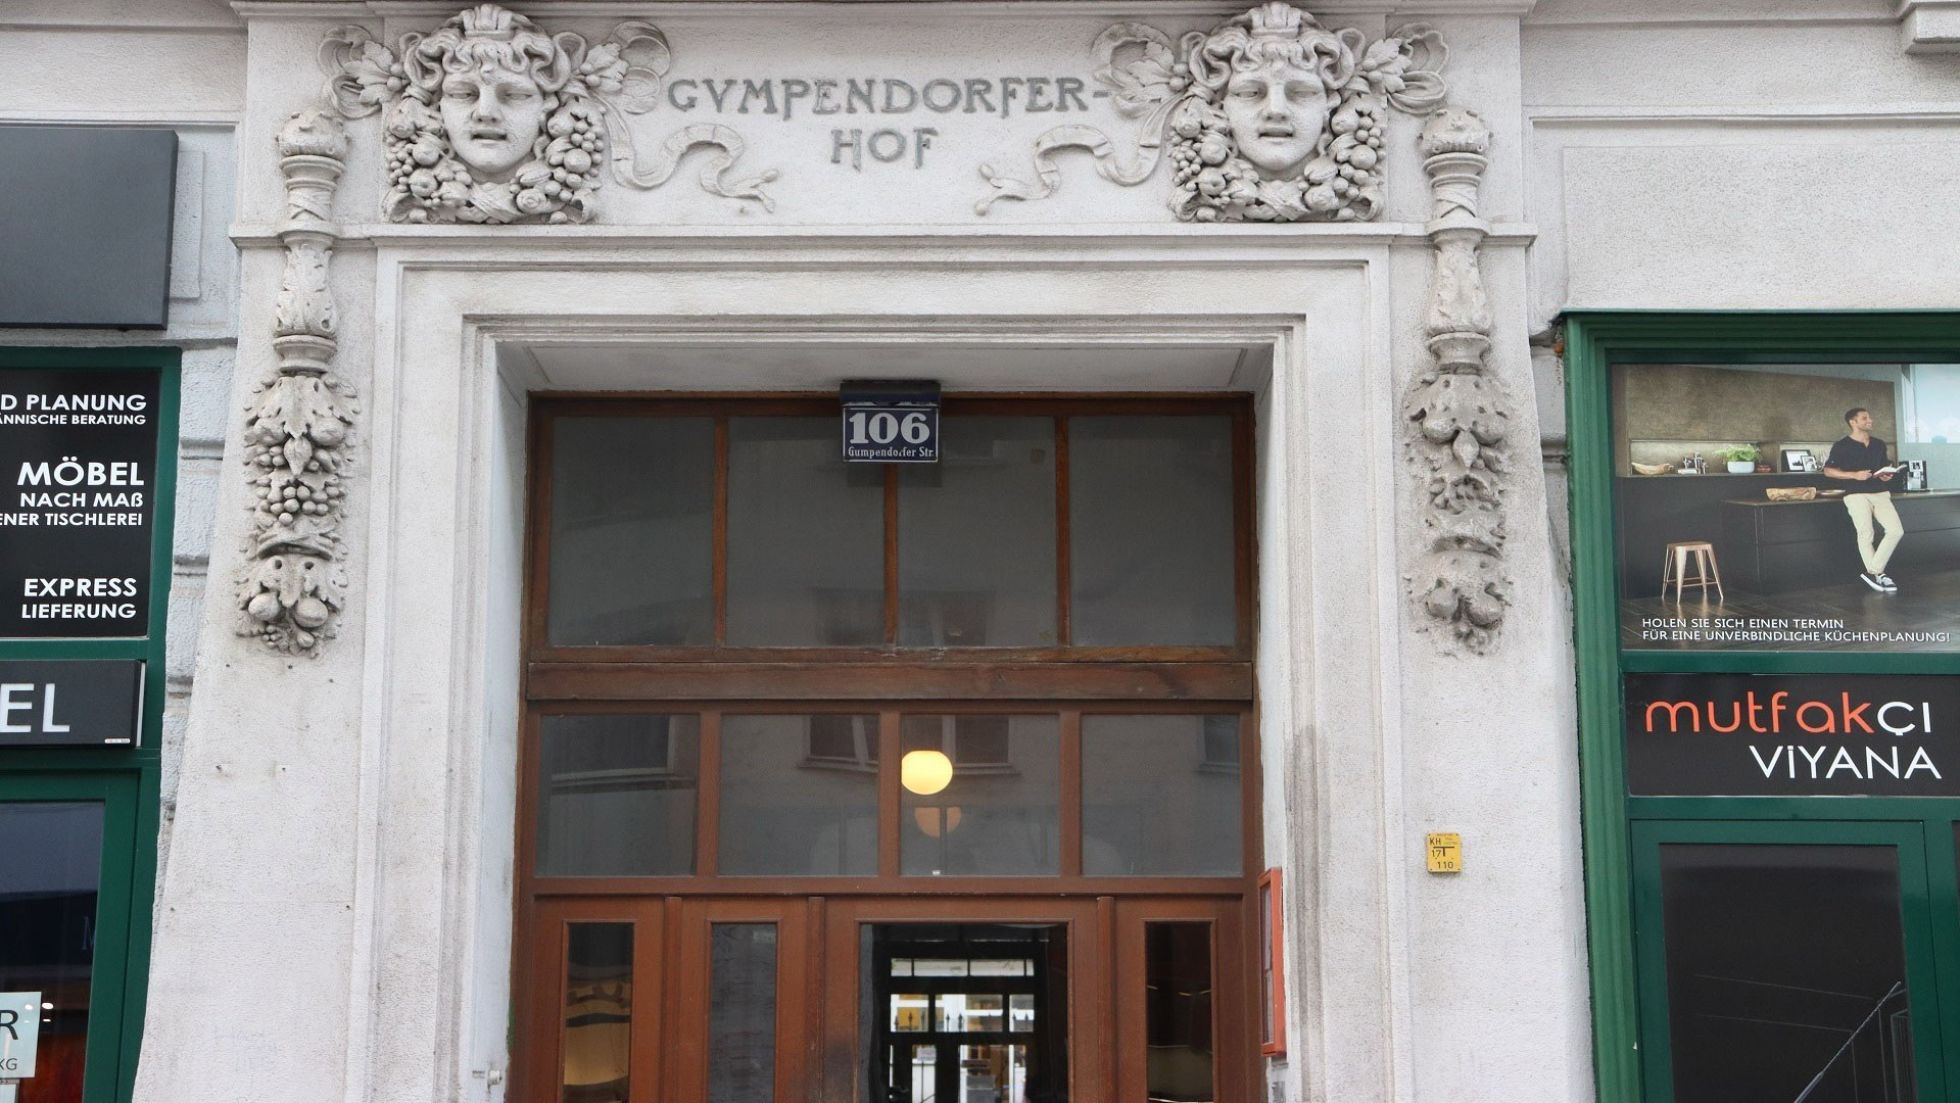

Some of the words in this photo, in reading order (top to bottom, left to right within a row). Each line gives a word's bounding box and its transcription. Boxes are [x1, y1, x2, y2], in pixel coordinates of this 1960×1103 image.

[831, 127, 938, 171] HOF
[26, 394, 147, 411] PLANUNG
[0, 412, 67, 425] NNISCHE
[71, 414, 147, 425] BERATUNG
[848, 412, 930, 444] 106
[848, 446, 917, 459] Gumpendorfer
[16, 456, 145, 487] MÖBEL
[19, 492, 87, 508] NACH
[45, 512, 143, 526] TISCHLEREI
[24, 577, 137, 597] EXPRESS
[21, 603, 137, 619] LIEFERUNG
[1641, 617, 1686, 629] HOLEN
[1691, 618, 1710, 628] SIE
[1714, 618, 1745, 629] SICH
[1749, 618, 1789, 629] EINEN
[1793, 619, 1844, 629] TERMIN
[1642, 629, 1668, 641] FÜR
[1672, 630, 1701, 641] EINE
[1705, 630, 1820, 642] UNVERBINDLICHE
[1824, 630, 1951, 643] KÜCHENPLANUNG!
[0, 683, 70, 733] EL
[1430, 837, 1441, 846] KH
[0, 1009, 19, 1041] R
